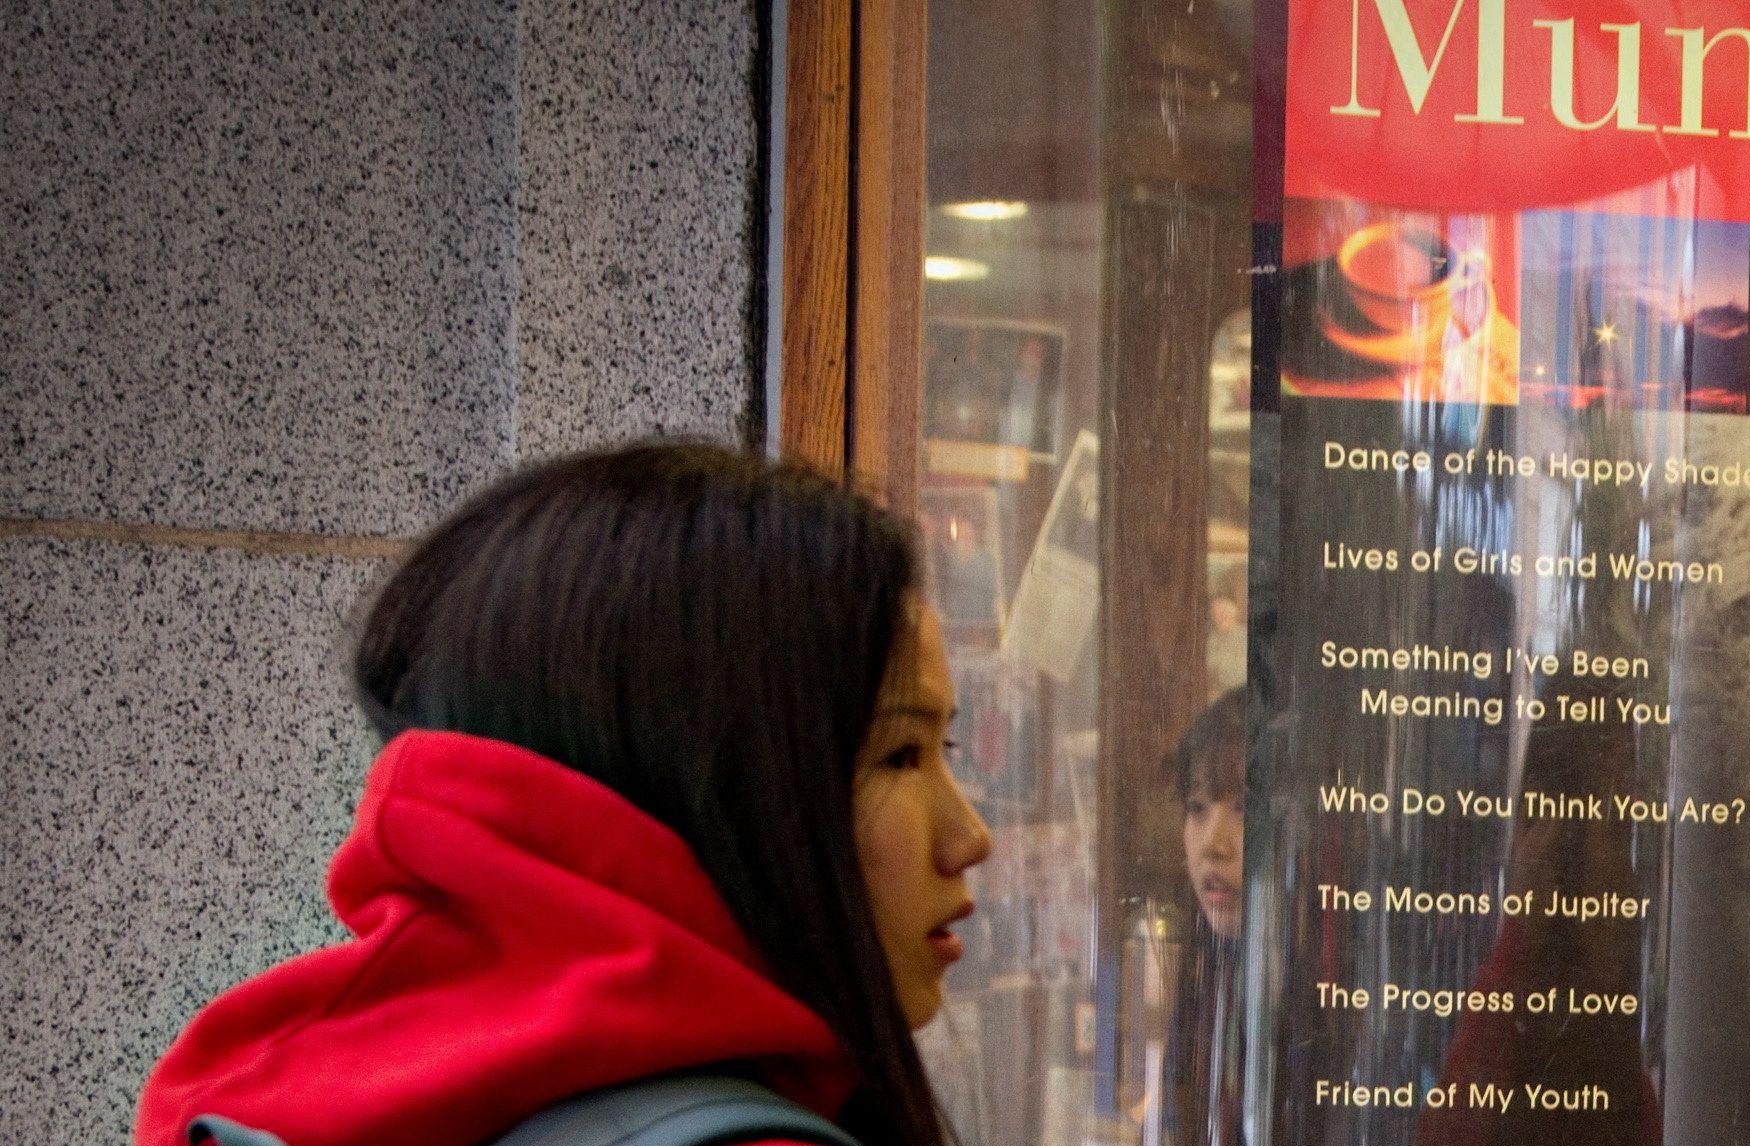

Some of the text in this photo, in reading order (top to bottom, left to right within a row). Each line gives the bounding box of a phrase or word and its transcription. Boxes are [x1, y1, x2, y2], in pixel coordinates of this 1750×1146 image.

[1325, 442, 1430, 473] Dance
[1444, 451, 1476, 475] of
[1486, 449, 1535, 477] the
[1549, 453, 1652, 489] Happy
[1324, 543, 1724, 583] Lives of Girls and Women
[1321, 642, 1649, 679] Something I've Been
[1360, 689, 1672, 725] Meaning to Tell You
[1320, 786, 1746, 824] Who Do You Think You Are?
[1318, 885, 1650, 922] The Moons of Jupiter
[1316, 983, 1639, 1017] The Progress of Love
[1316, 1080, 1609, 1114] Friend of My Youth
